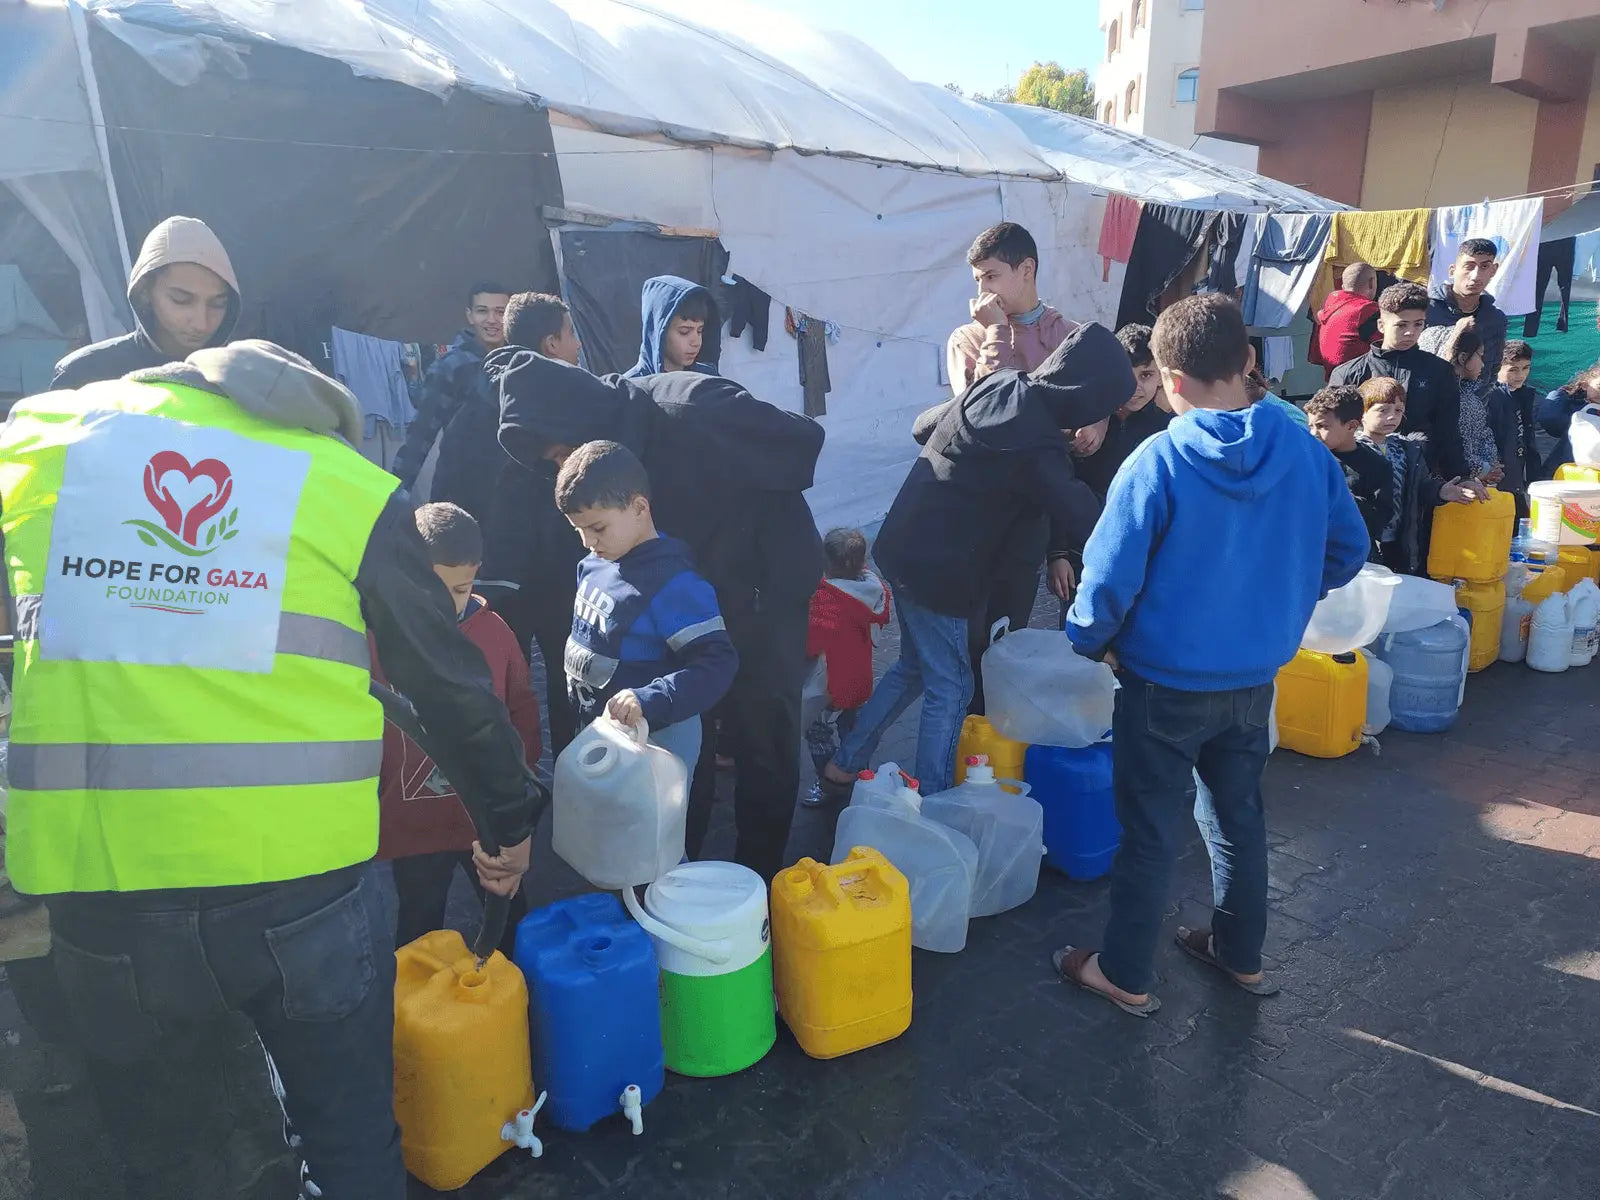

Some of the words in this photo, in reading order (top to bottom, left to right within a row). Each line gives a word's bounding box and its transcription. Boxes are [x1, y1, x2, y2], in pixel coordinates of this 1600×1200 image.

[61, 556, 143, 581] HOPE
[149, 563, 200, 585] FOR
[206, 568, 268, 589] GAZA
[105, 586, 230, 605] FOUNDATION
